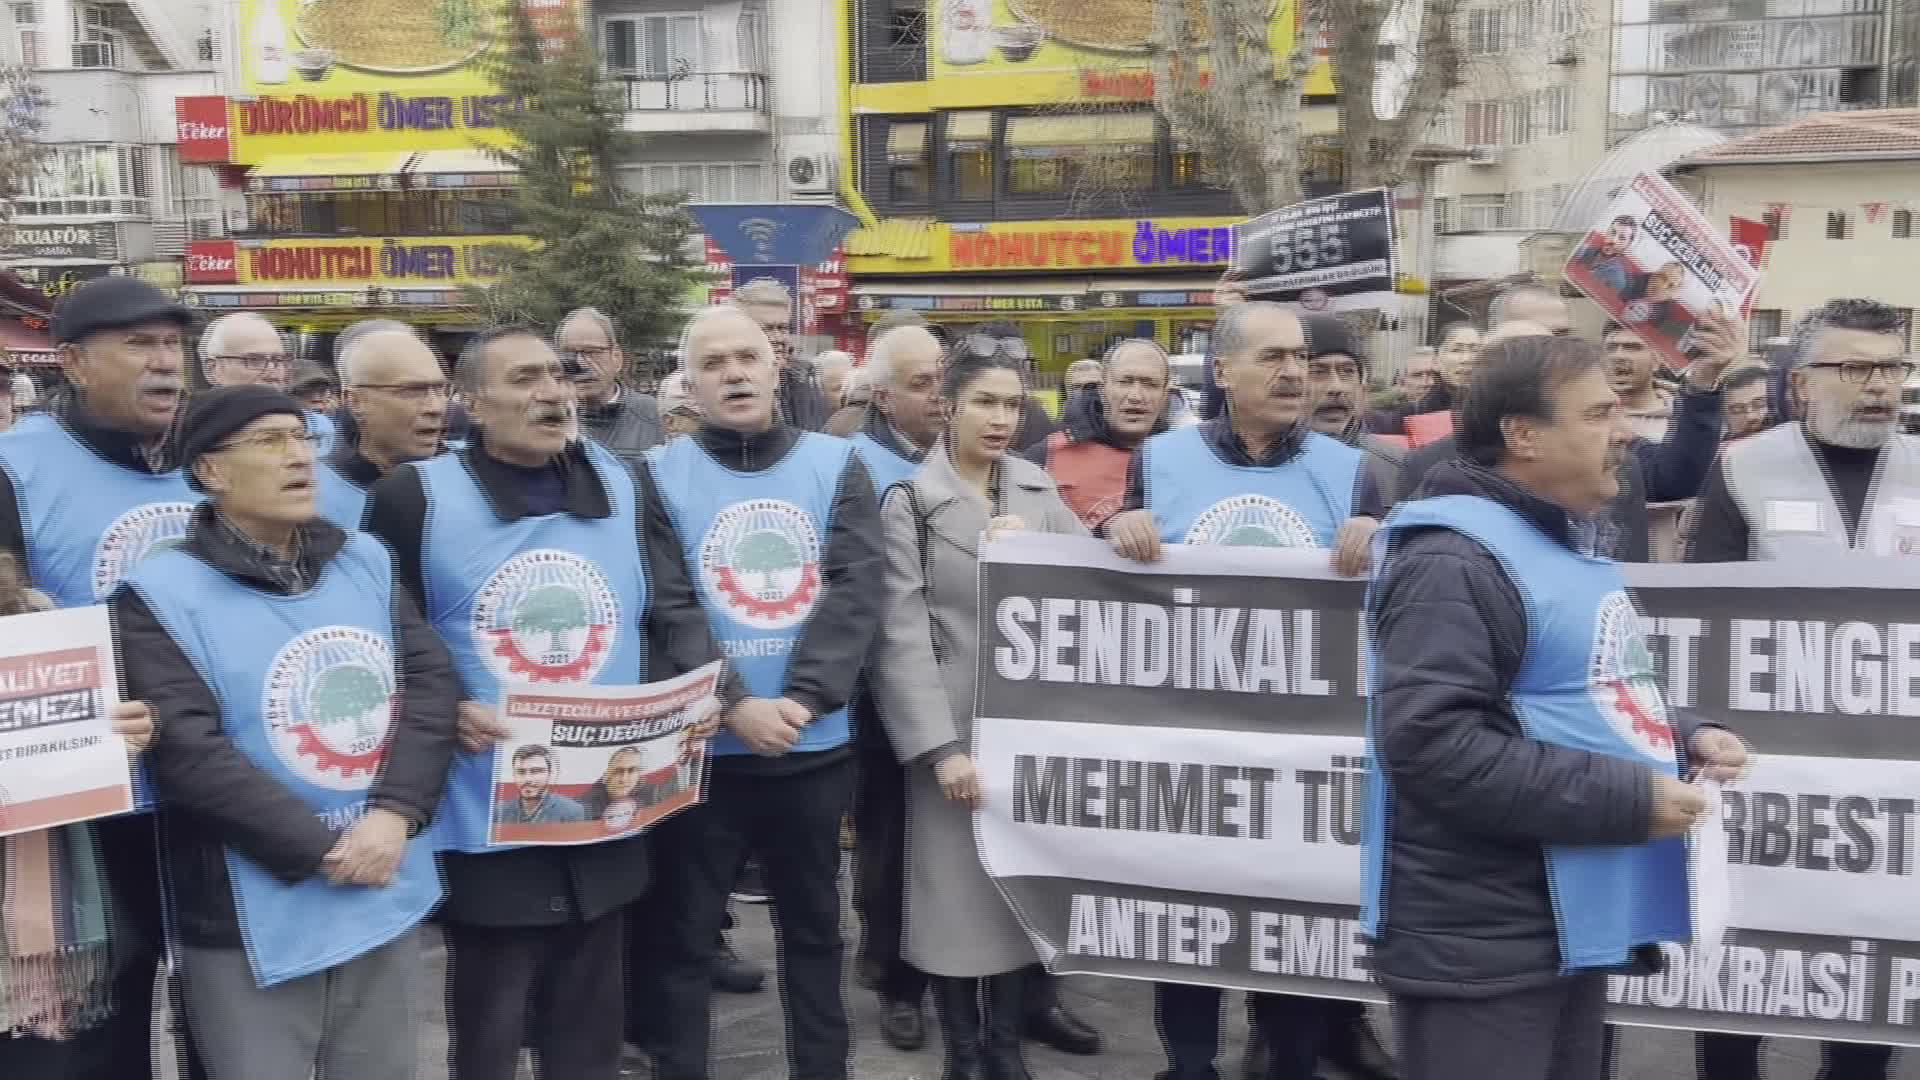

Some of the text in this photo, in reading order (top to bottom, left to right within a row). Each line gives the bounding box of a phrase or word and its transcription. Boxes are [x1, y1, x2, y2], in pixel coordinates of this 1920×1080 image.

[241, 92, 370, 135] DÜRÜMCÜ
[376, 91, 455, 130] ÖMER
[15, 225, 93, 245] KUAFÖR
[948, 230, 1126, 268] NOHUTCU
[1131, 219, 1231, 264] ÖMER
[1271, 222, 1345, 273] 555
[1644, 213, 1673, 244] SUÇ
[250, 245, 374, 280] NOHUTCU
[379, 237, 456, 279] ÖMER
[540, 652, 571, 665] 2021
[994, 586, 1334, 696] SENDİKAL
[351, 736, 379, 753] 2021
[552, 724, 599, 745] SUÇ
[1013, 754, 1280, 839] MEHMET
[1067, 894, 1370, 981] ANTEP EME
